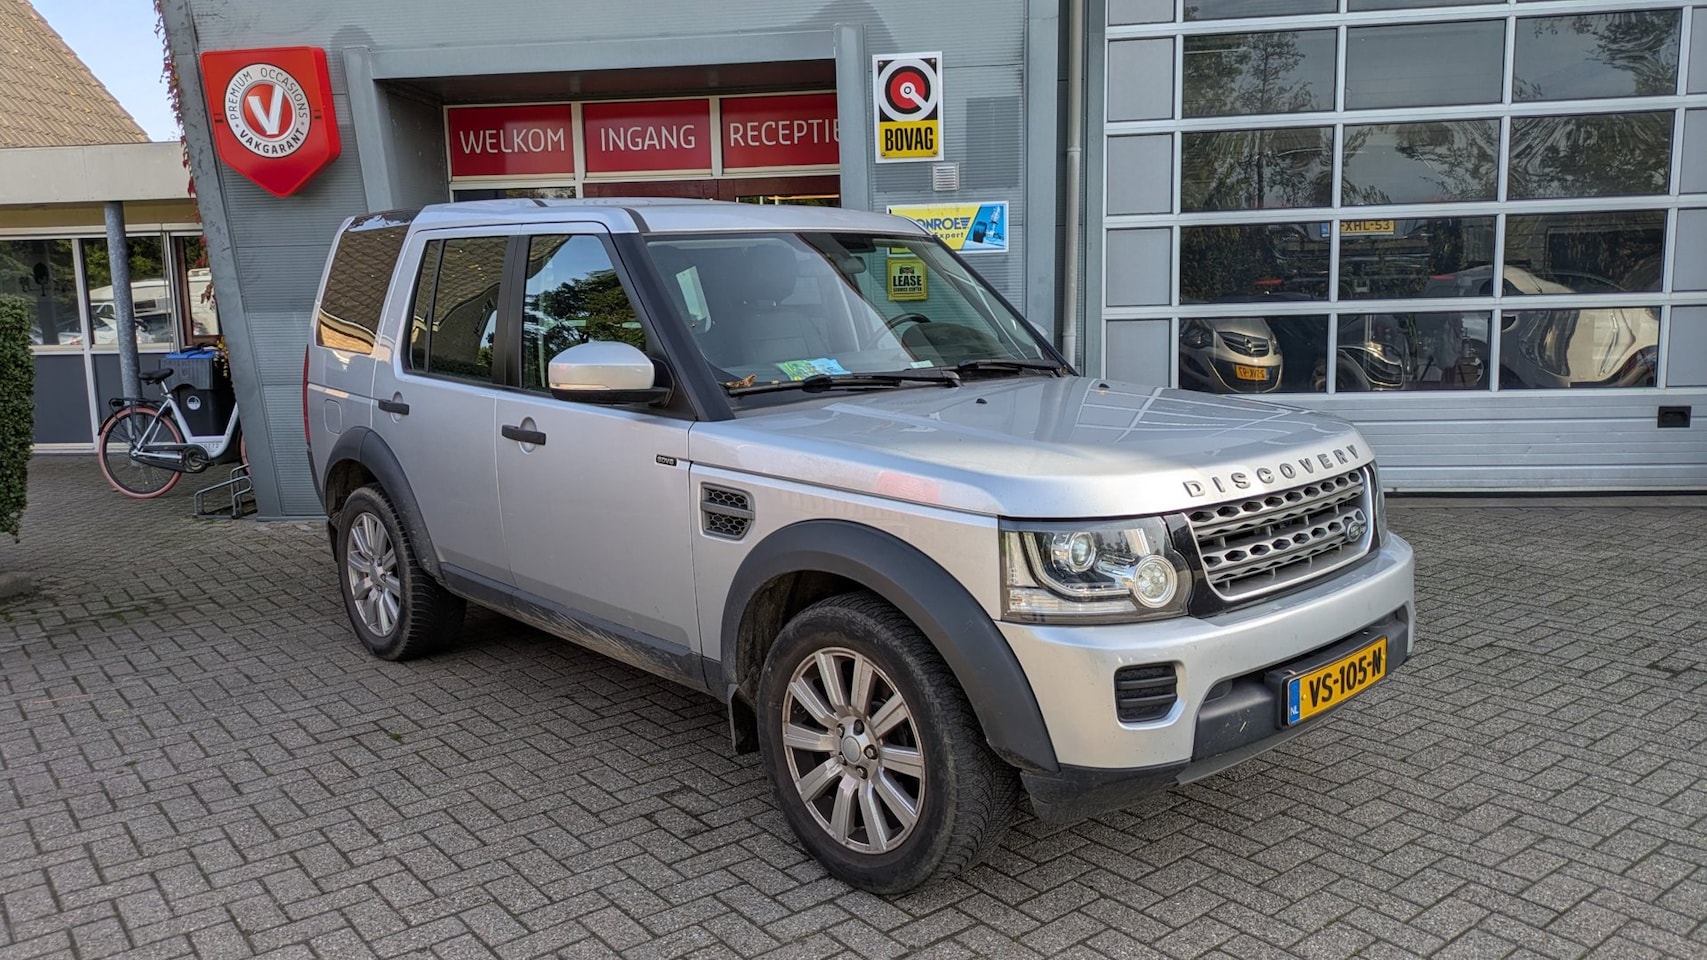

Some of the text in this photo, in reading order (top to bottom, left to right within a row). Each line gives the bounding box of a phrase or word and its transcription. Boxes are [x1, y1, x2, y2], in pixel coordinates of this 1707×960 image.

[228, 67, 308, 120] PREMIUM OCCASIONS
[240, 127, 305, 155] VAKGARANT
[459, 127, 566, 154] WELKOM
[600, 124, 696, 152] INGANG
[884, 126, 934, 152] BOVAG
[916, 217, 962, 231] ONROE
[1340, 220, 1391, 232] -XHL-53
[892, 275, 923, 287] LEASE
[1182, 444, 1360, 498] DISCOVERY
[1290, 646, 1382, 716] NL VS-105-N
